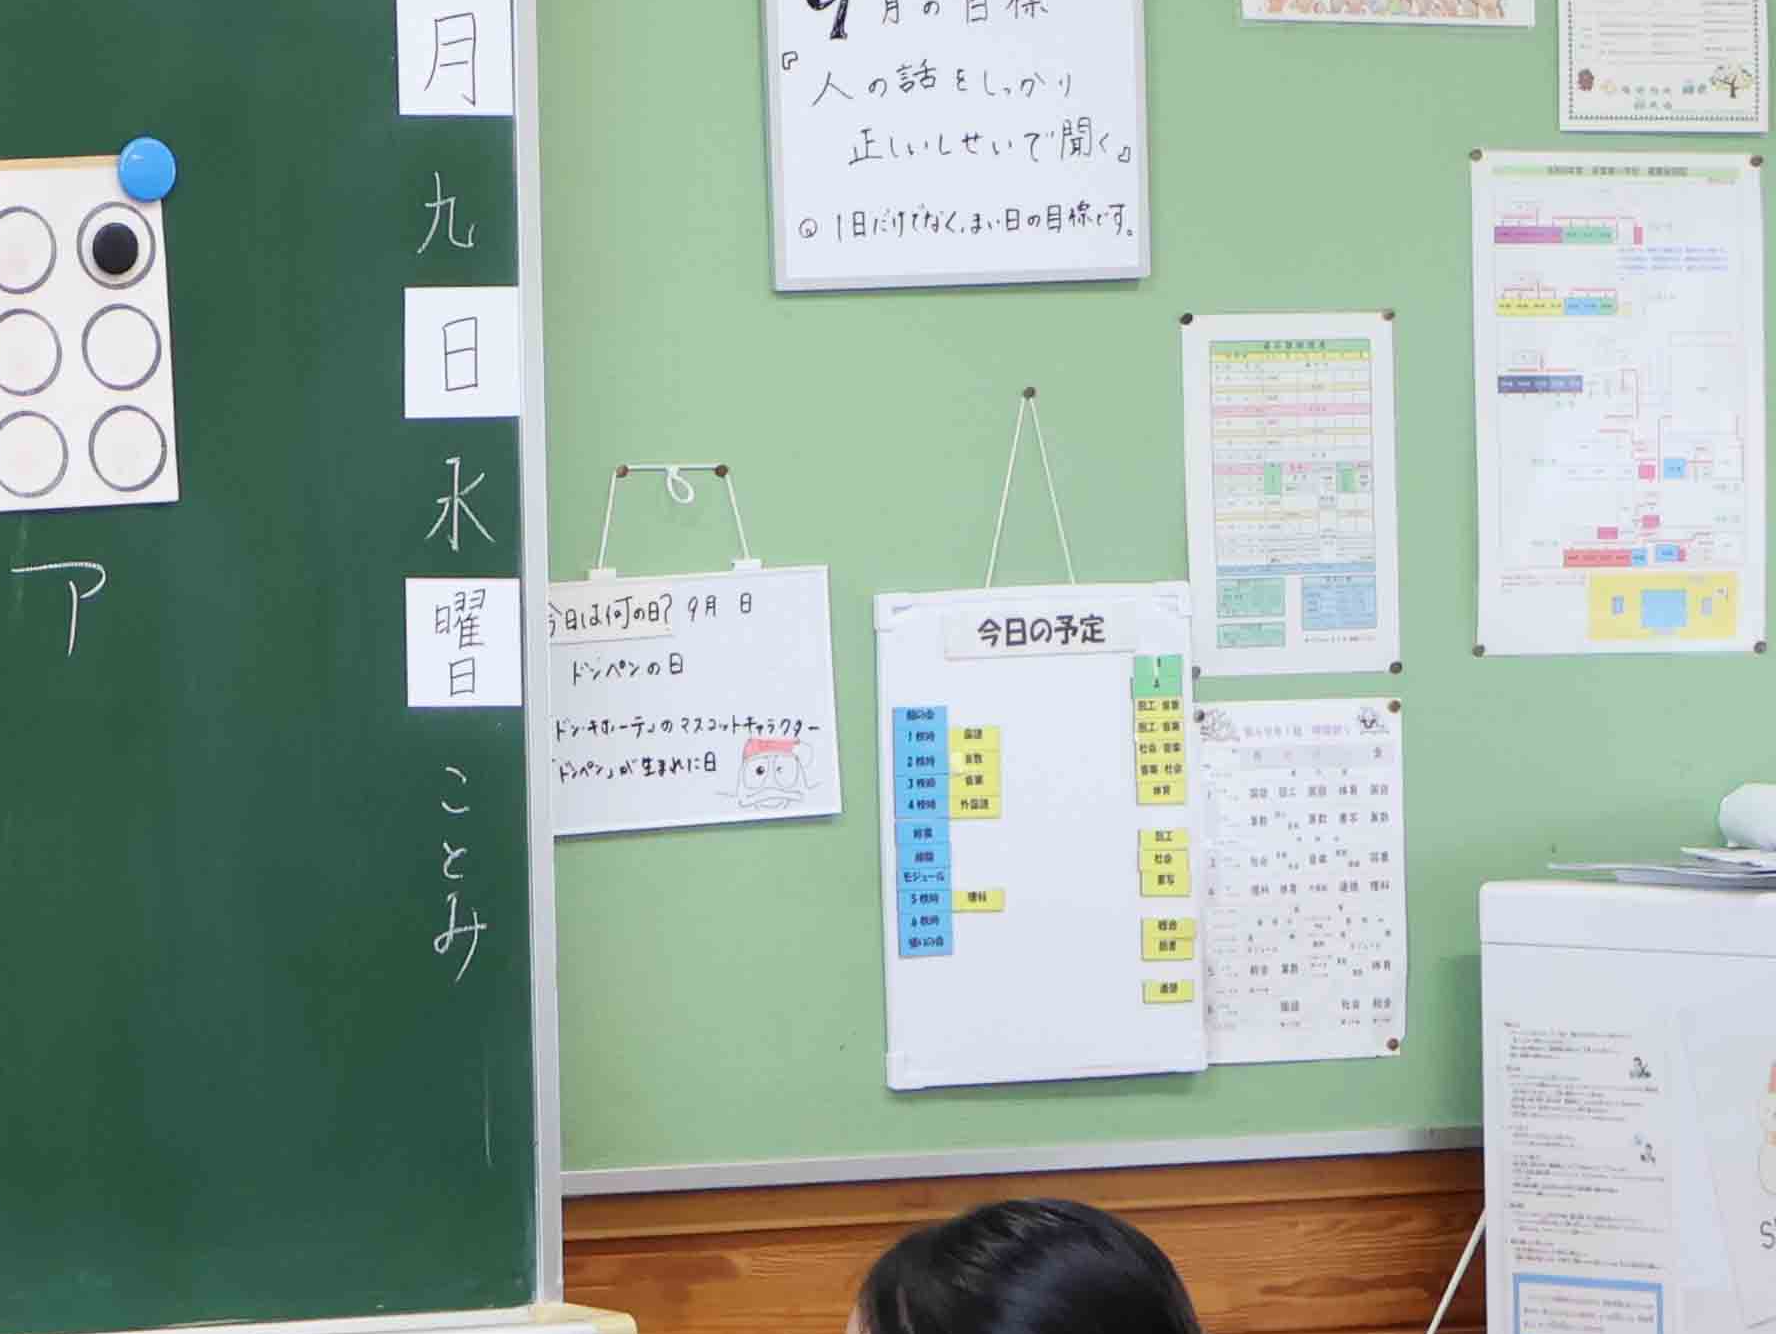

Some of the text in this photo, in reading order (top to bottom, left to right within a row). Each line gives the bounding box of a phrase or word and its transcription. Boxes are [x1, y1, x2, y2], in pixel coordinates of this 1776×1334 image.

[10, 558, 107, 657] ア
[688, 596, 717, 622] 9月
[740, 592, 752, 613] 日
[976, 614, 1107, 648] 今日の予定
[573, 652, 684, 686] ドンペンの日
[434, 767, 486, 981] ことみ
[1760, 1218, 1776, 1249] S
